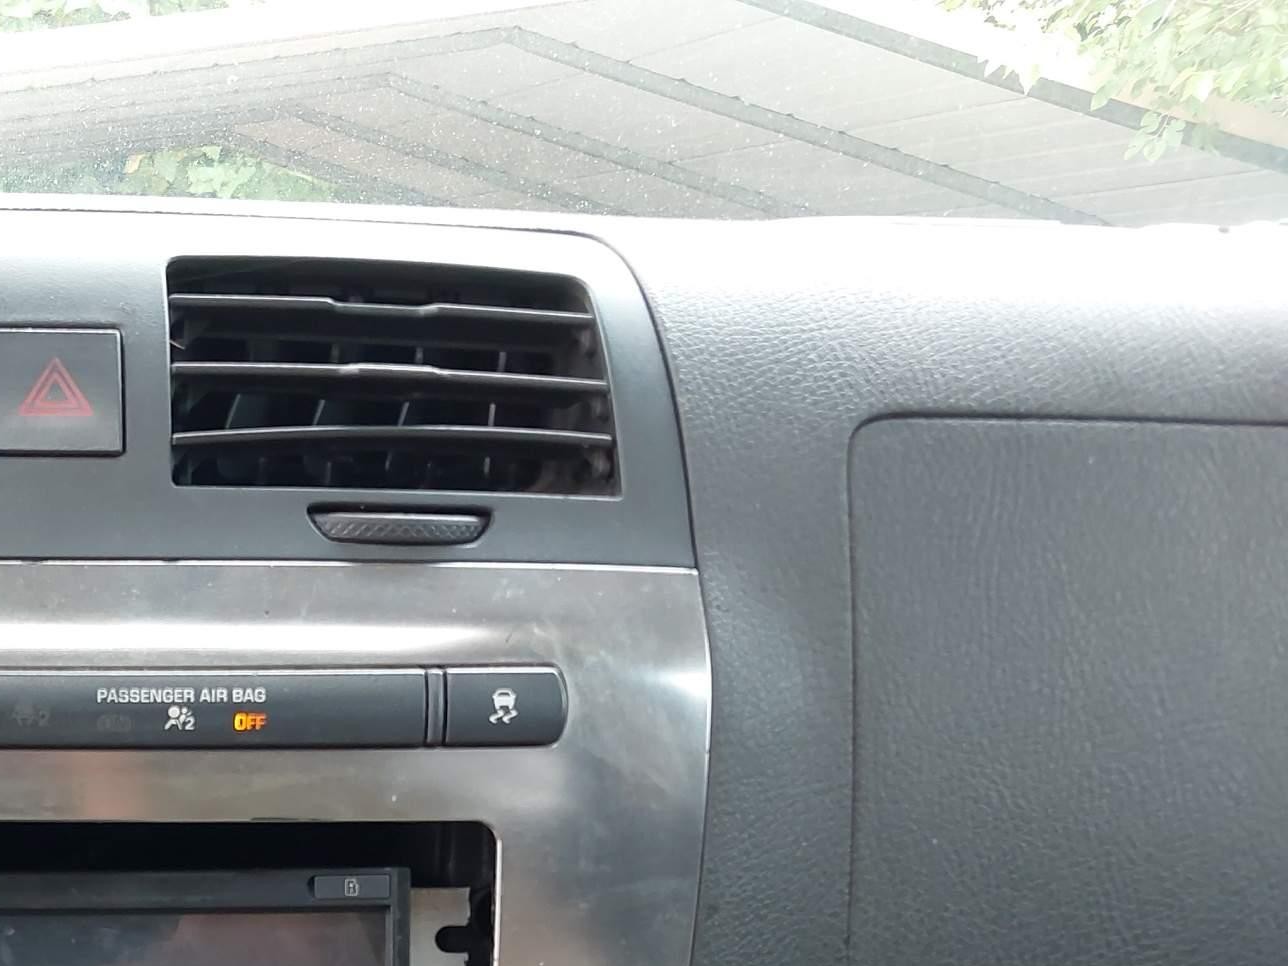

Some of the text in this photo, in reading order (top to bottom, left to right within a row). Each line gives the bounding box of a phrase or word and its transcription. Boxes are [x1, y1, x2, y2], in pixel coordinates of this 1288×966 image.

[96, 686, 267, 704] PASSENGER AIR BAG
[234, 712, 267, 732] OFF
